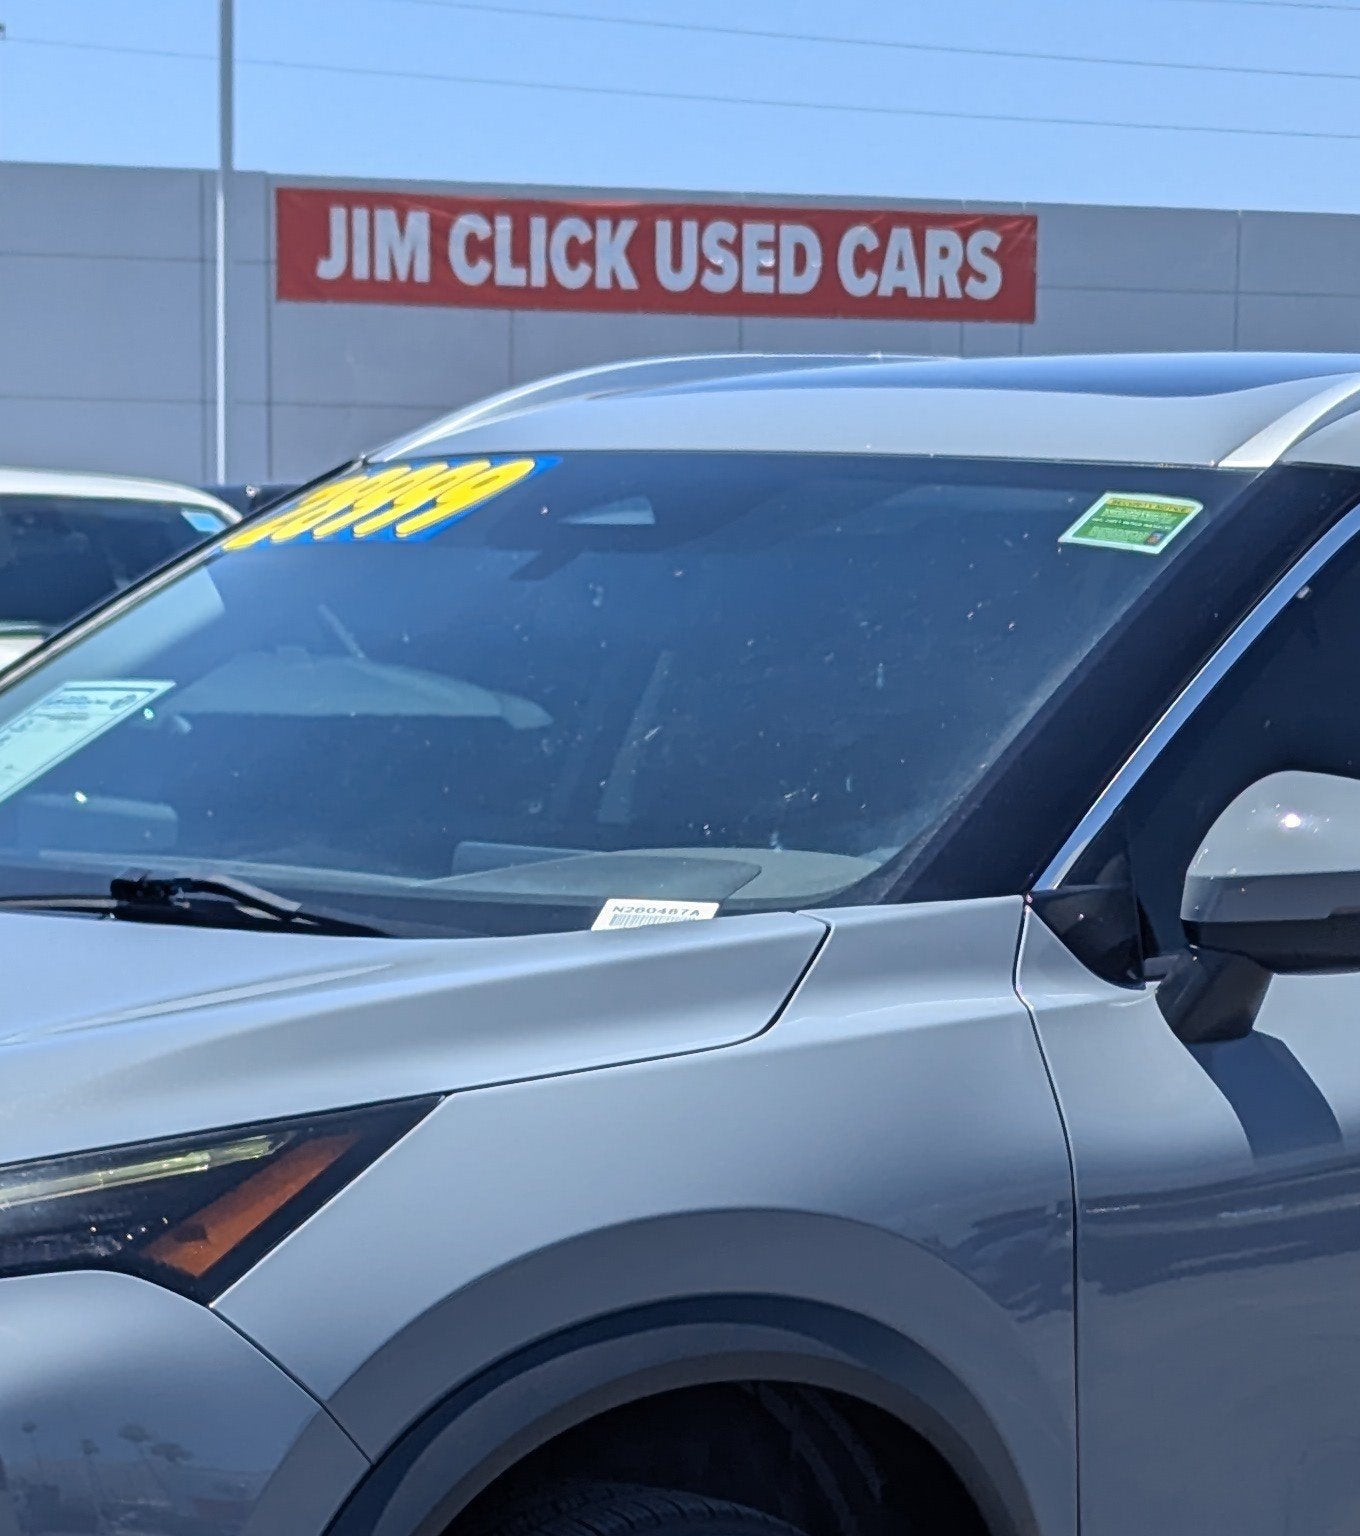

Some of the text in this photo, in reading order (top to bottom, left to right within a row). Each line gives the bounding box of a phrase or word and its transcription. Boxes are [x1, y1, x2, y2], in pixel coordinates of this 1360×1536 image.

[316, 205, 1004, 301] JIM CLICK USED CARS
